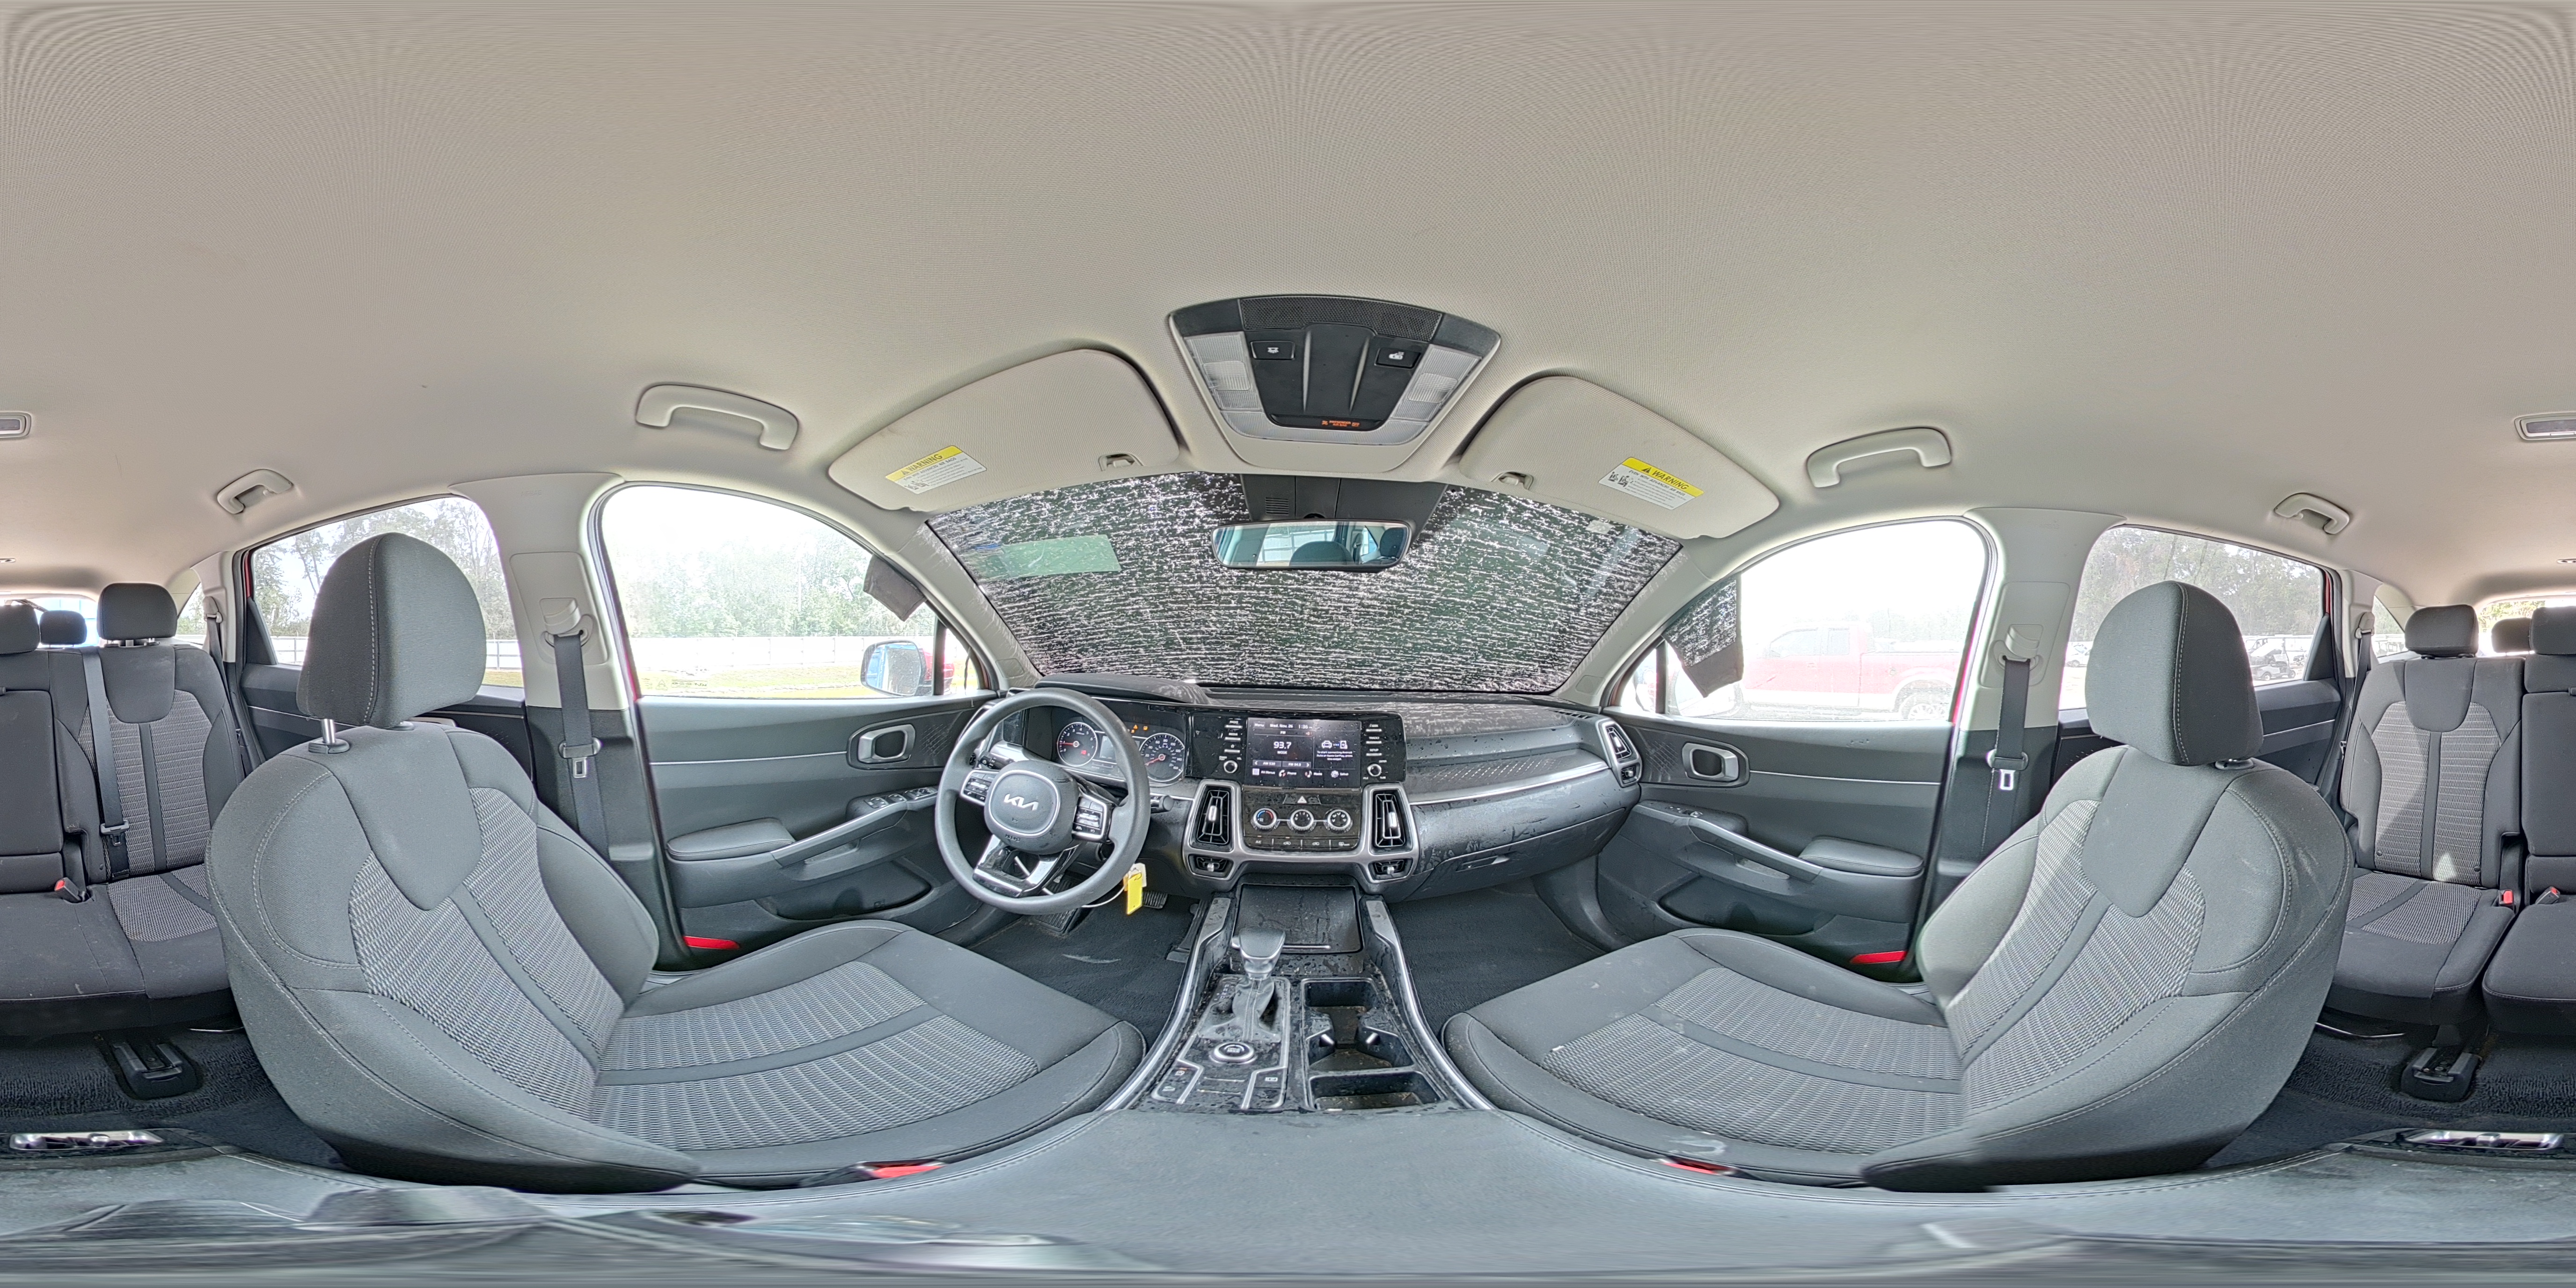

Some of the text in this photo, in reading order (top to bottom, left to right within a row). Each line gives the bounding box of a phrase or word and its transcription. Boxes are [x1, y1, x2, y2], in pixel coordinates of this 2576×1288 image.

[906, 454, 943, 471] WARNING
[1650, 479, 1670, 489] ADVANCED
[1652, 470, 1689, 490] WARNING
[1003, 793, 1039, 811] KIA
